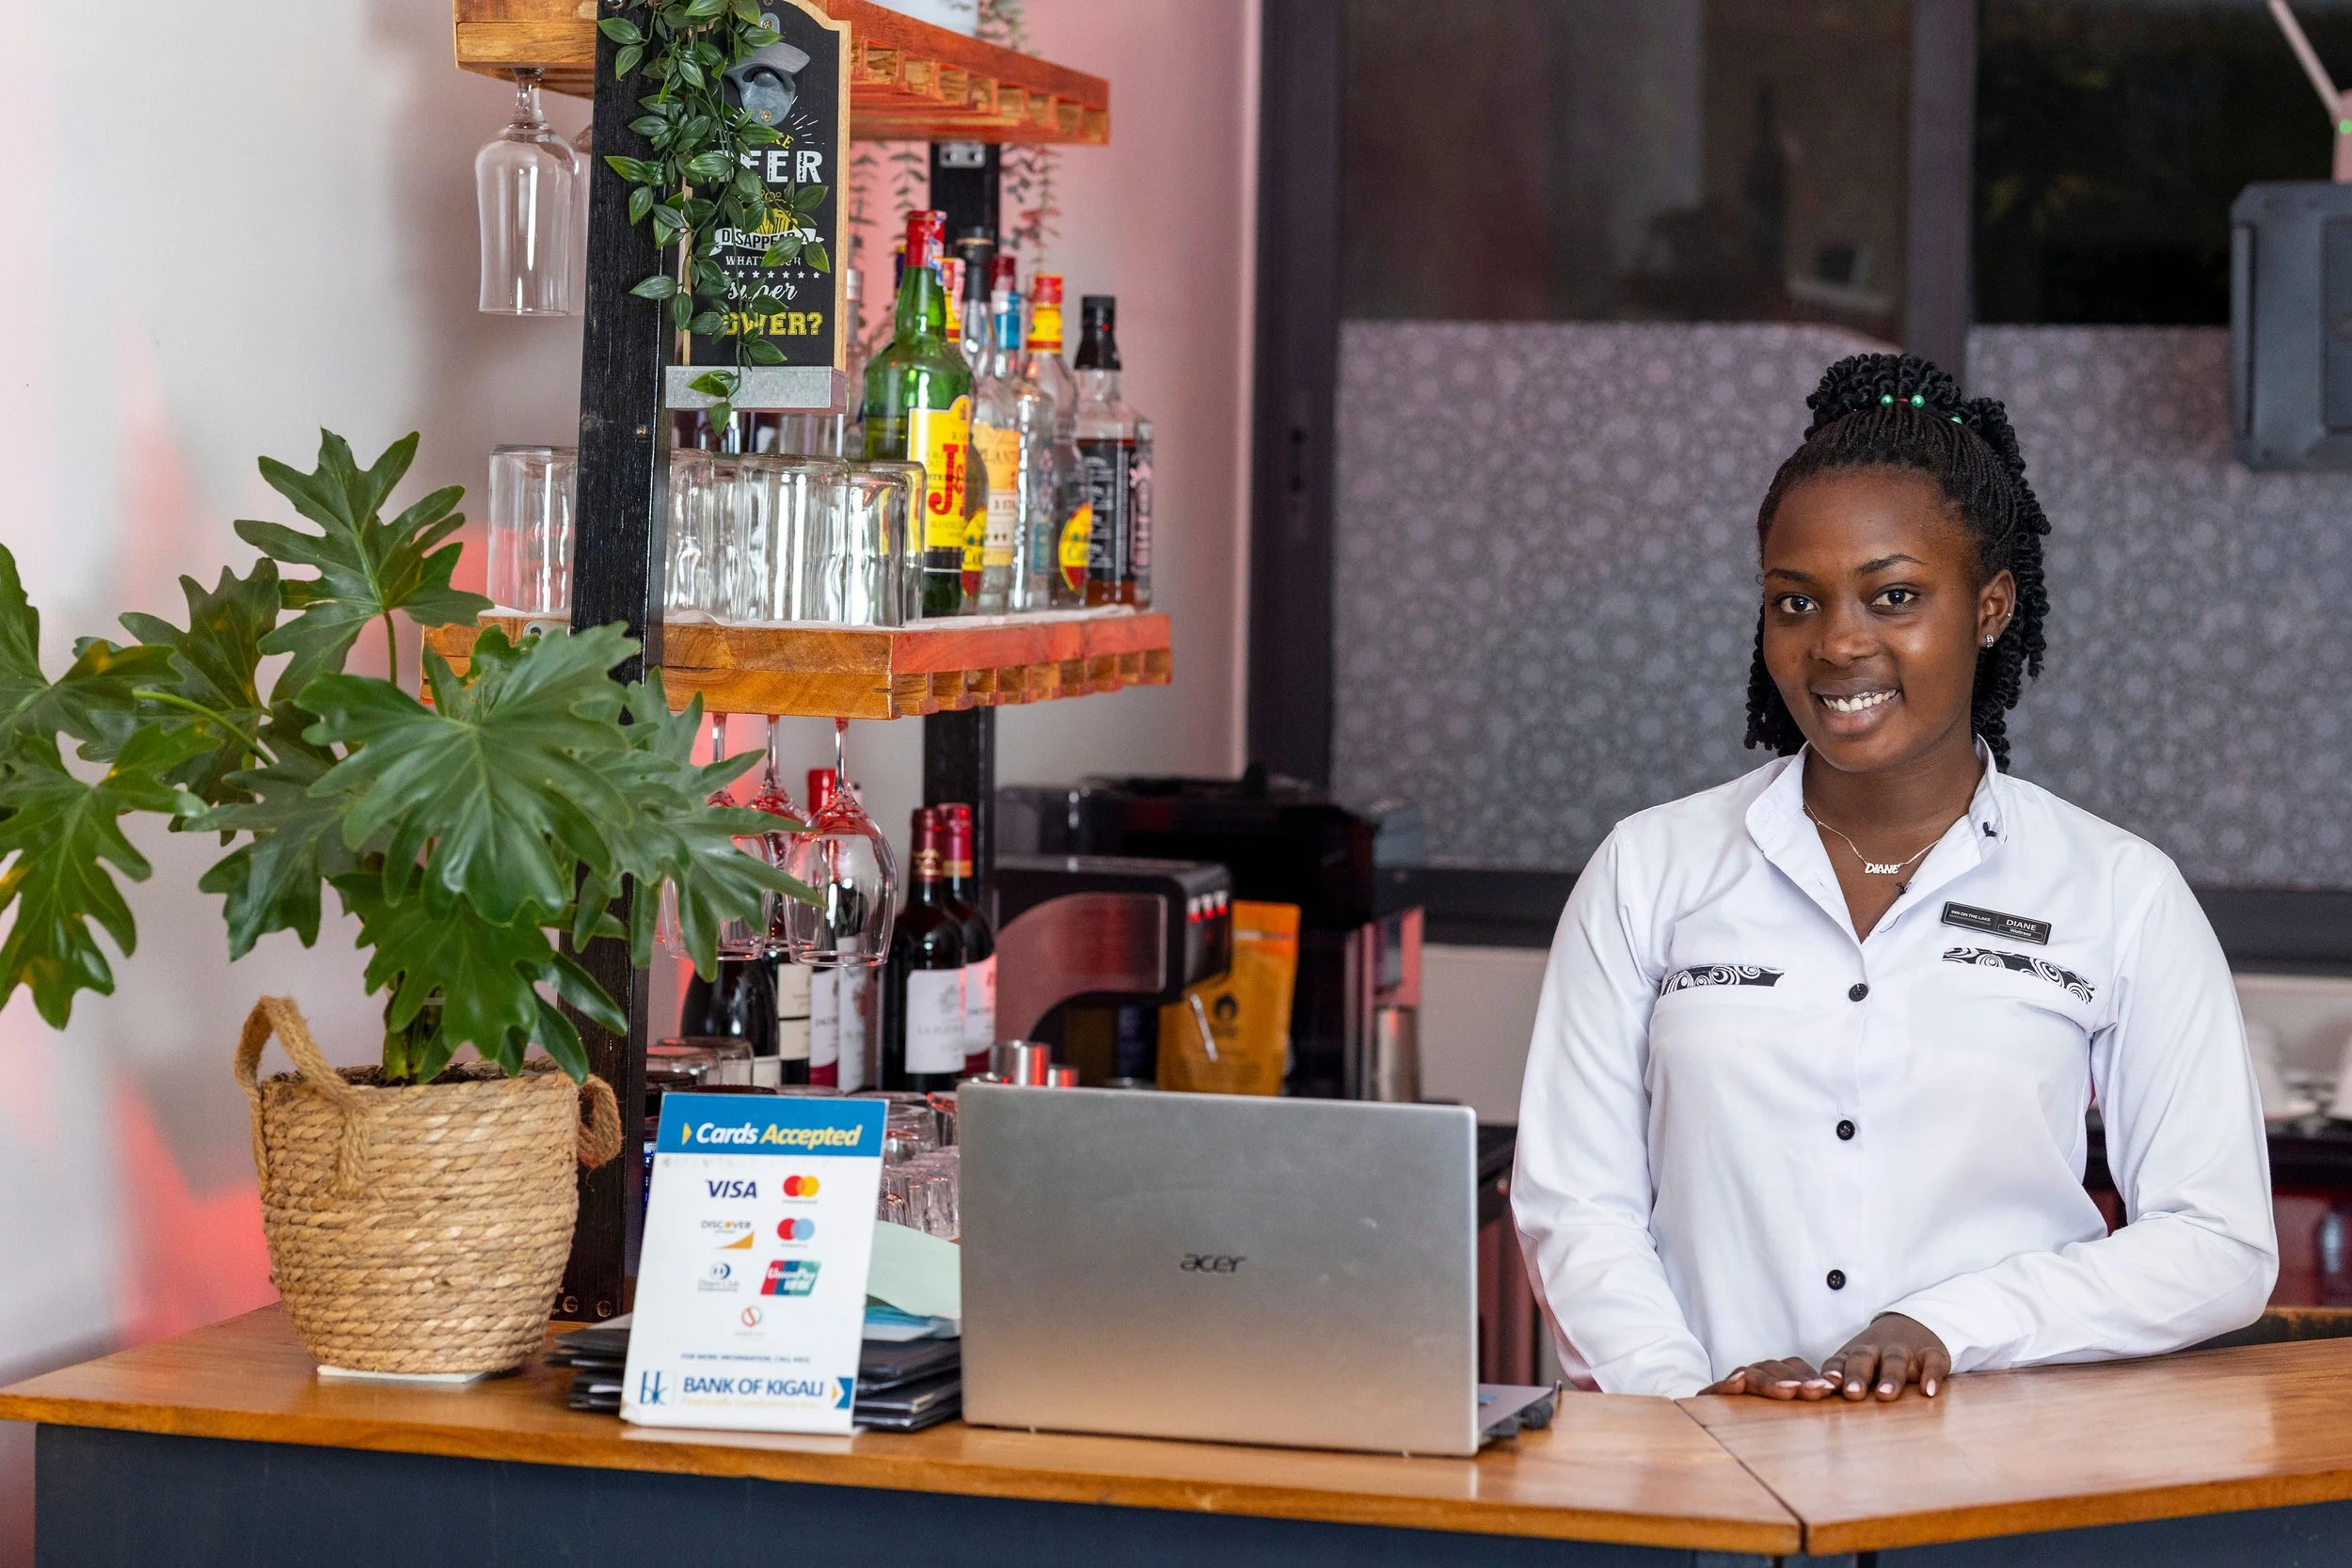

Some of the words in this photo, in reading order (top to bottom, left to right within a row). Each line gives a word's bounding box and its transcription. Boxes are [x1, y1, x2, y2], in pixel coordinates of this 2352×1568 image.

[710, 150, 823, 182] EER
[725, 255, 765, 266] WHAT'
[708, 311, 823, 336] OWER?
[1865, 863, 1900, 874] DIANE
[2006, 919, 2037, 931] DIANE
[2010, 927, 2032, 937] Waitress
[696, 1122, 759, 1145] Cards
[759, 1123, 864, 1150] Accepted
[707, 1180, 757, 1198] VISA
[1180, 1253, 1247, 1273] acer
[683, 1376, 734, 1395] BANK
[738, 1378, 764, 1395] OF
[766, 1379, 825, 1398] KIGALI
